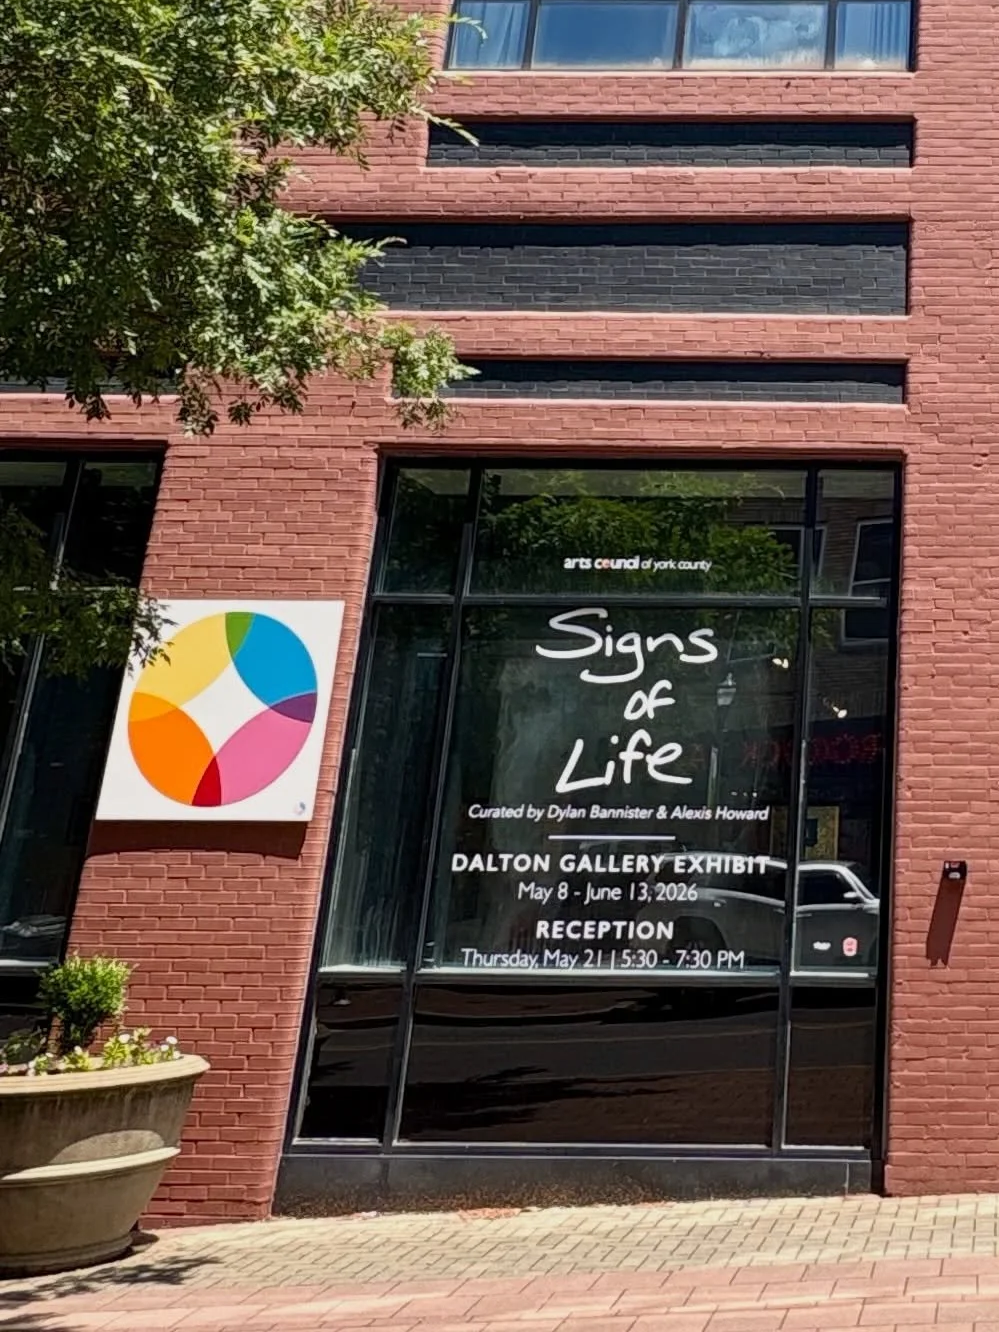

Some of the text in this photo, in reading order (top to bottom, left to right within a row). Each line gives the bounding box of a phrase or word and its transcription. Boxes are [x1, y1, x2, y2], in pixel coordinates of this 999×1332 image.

[563, 556, 592, 569] arts
[641, 557, 653, 569] of
[653, 558, 677, 572] york
[678, 559, 713, 572] county
[535, 607, 718, 684] Signs
[624, 679, 676, 720] of
[555, 728, 693, 793] Life
[468, 804, 770, 822] Curated by Dylan Bannister & Alexis Howard
[451, 853, 771, 874] DALTON GALLERY EXHIBIT
[517, 881, 553, 905] May
[557, 881, 569, 900] 8
[584, 881, 622, 905] June
[655, 882, 699, 901] 2026
[535, 920, 674, 940] RECEPTION
[461, 948, 539, 969] Thursday,
[543, 949, 578, 969] May
[583, 949, 602, 968] 21
[620, 949, 658, 968] 5:30
[675, 950, 712, 969] 7:30
[717, 950, 745, 969] PM
